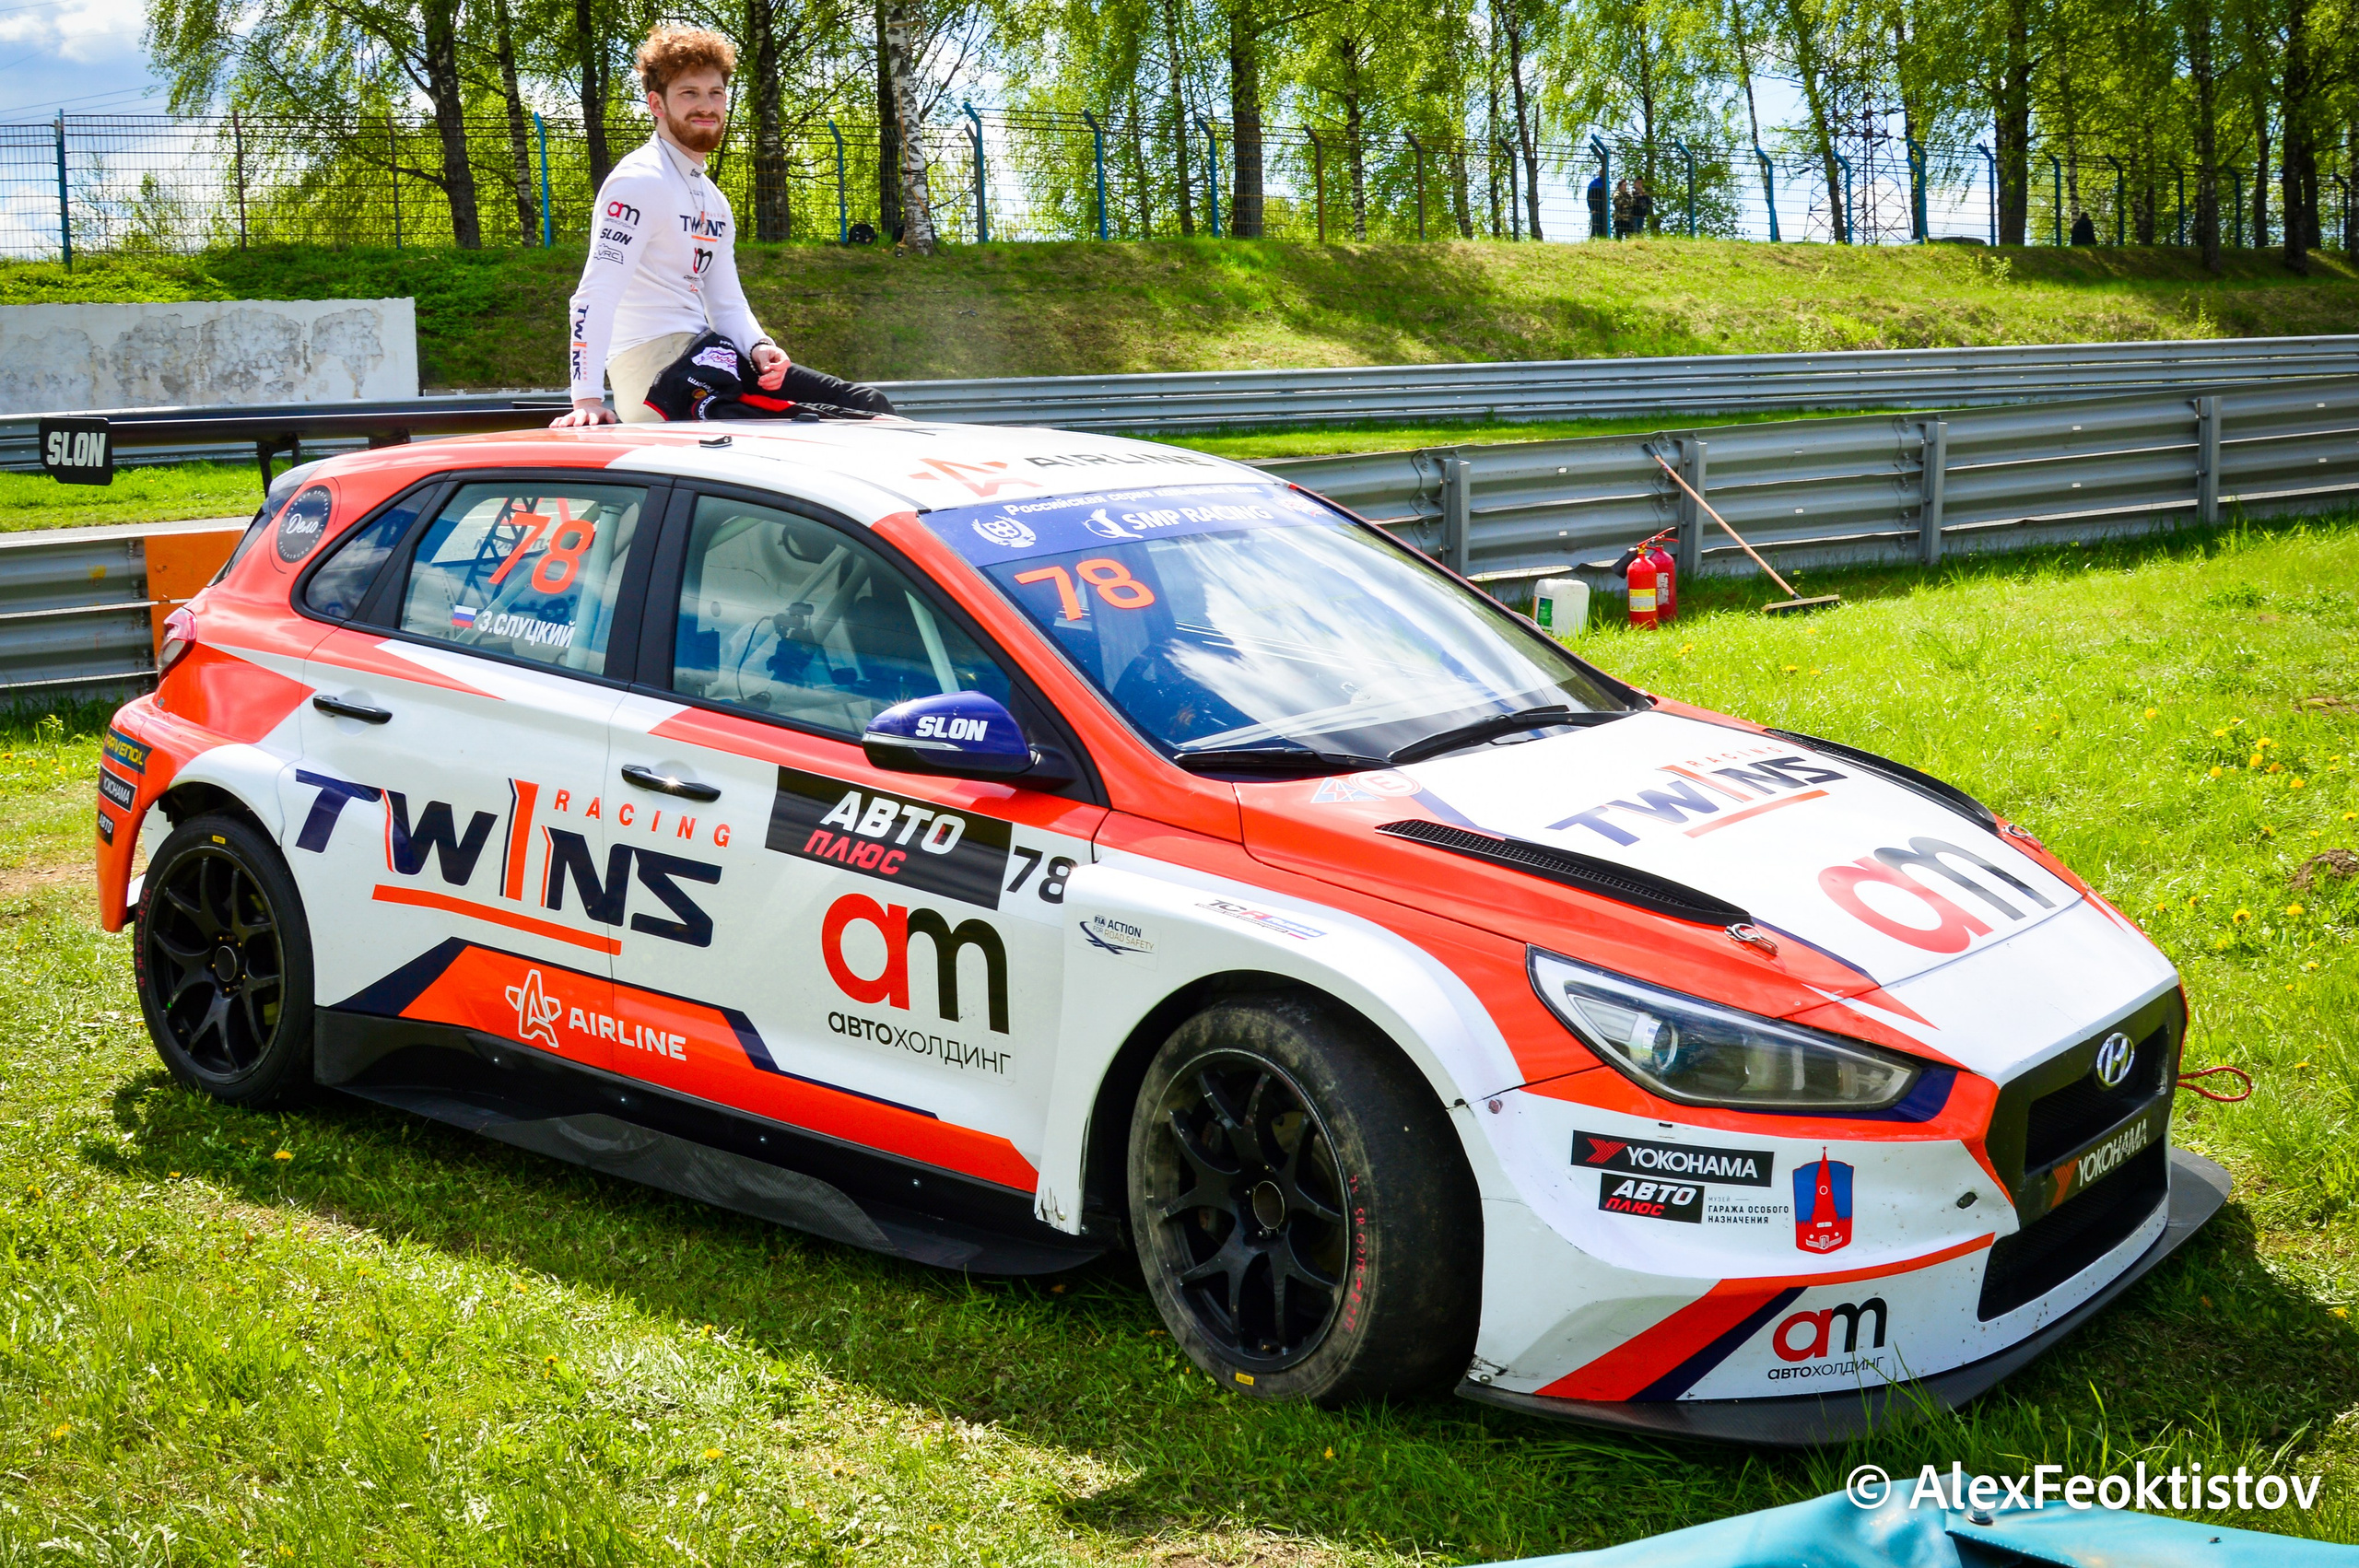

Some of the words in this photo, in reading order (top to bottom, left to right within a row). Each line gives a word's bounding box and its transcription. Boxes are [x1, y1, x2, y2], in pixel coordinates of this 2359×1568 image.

[600, 228, 633, 245] SLON
[572, 305, 590, 380] TWINS
[46, 430, 106, 468] SLON
[1003, 495, 1107, 516] Российская
[1109, 490, 1154, 503] серия
[1121, 509, 1180, 531] SMP
[1178, 505, 1274, 523] RACING
[487, 511, 595, 594] 78
[1014, 558, 1156, 622] 78
[915, 715, 989, 743] SLON
[106, 734, 144, 766] RAVENOL
[1686, 745, 1784, 768] RACING
[103, 775, 131, 805] YOKOHAMA
[1544, 756, 1848, 848] TWINS
[554, 789, 731, 849] RACING
[819, 790, 967, 857] АВТО
[295, 768, 723, 949] TWINS
[803, 828, 908, 876] ПЛЮС
[1005, 845, 1079, 906] 78
[1093, 925, 1104, 934] FOR
[1104, 929, 1124, 942] ROAD
[1125, 935, 1155, 952] SAFETY
[1094, 916, 1106, 926] FIA
[1107, 919, 1142, 938] ACTION
[568, 1007, 687, 1063] AIRLINE
[827, 1010, 1012, 1076] автохолдинг
[1626, 1145, 1758, 1179] YOKOHAMA
[2078, 1117, 2147, 1187] YOKOHAMA
[1605, 1198, 1665, 1216] ПЛЮС
[1612, 1179, 1697, 1206] АВТО
[1708, 1205, 1745, 1214] ГАРАЖА
[1747, 1205, 1790, 1214] ОСОБОГО
[1708, 1215, 1769, 1224] НАЗНАЧЕНИЯ
